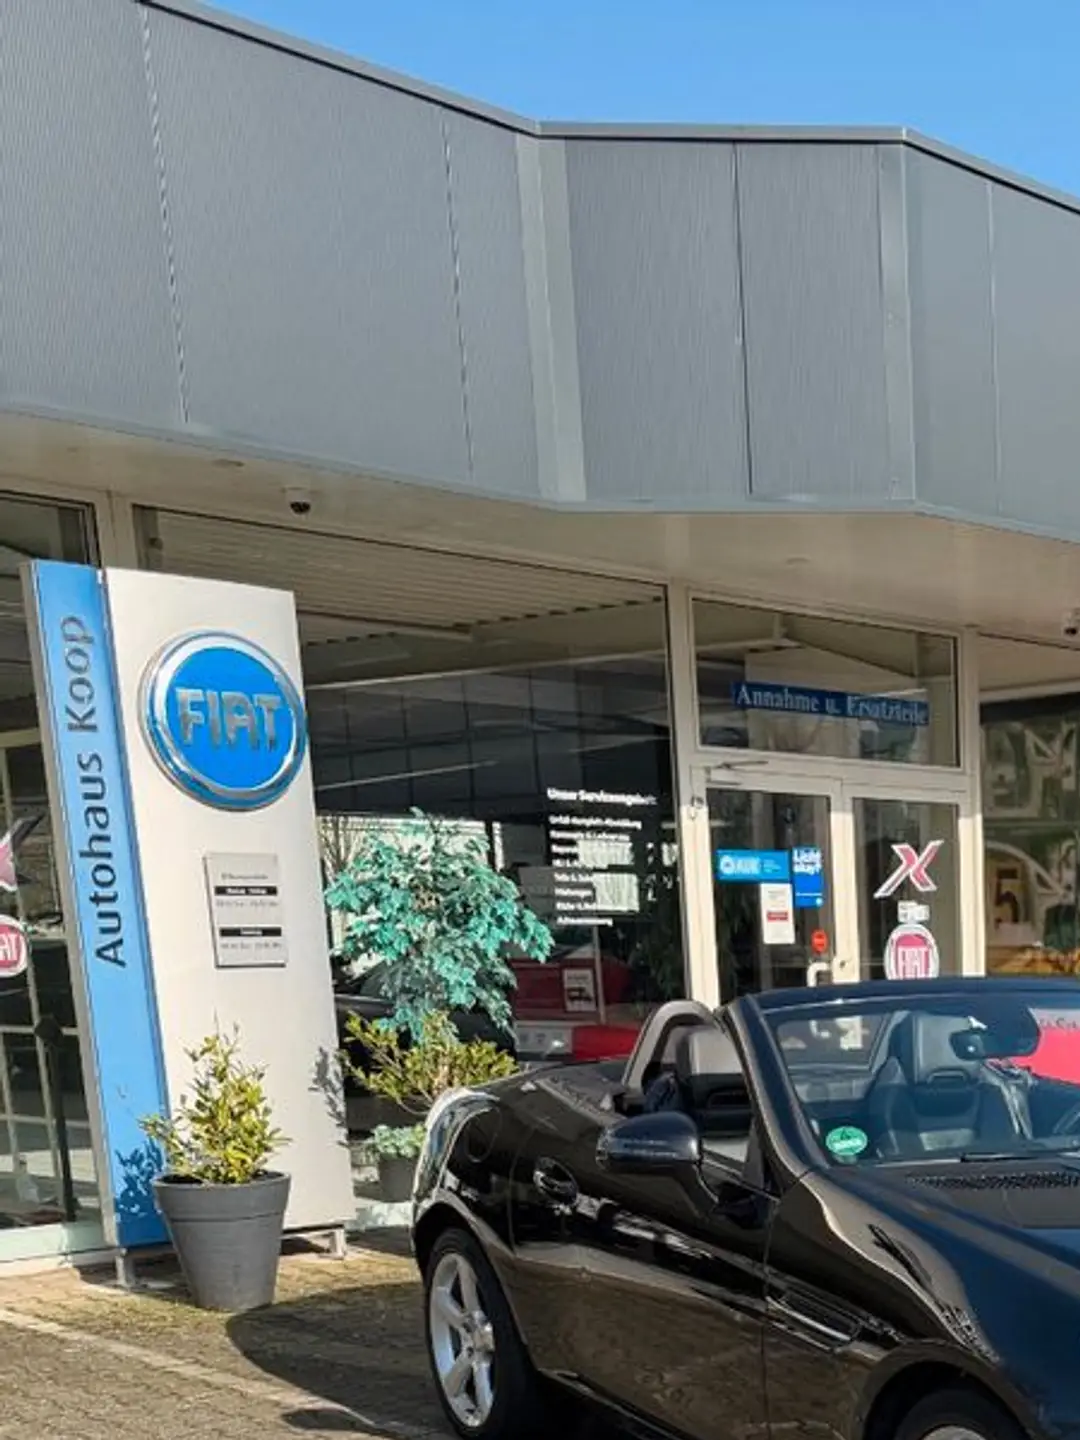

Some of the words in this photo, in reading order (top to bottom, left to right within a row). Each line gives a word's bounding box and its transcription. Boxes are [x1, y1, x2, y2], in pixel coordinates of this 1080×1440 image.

[61, 616, 98, 733] Koop
[175, 686, 282, 751] FIAT
[736, 684, 820, 712] Annahme
[77, 752, 126, 968] Autohaus
